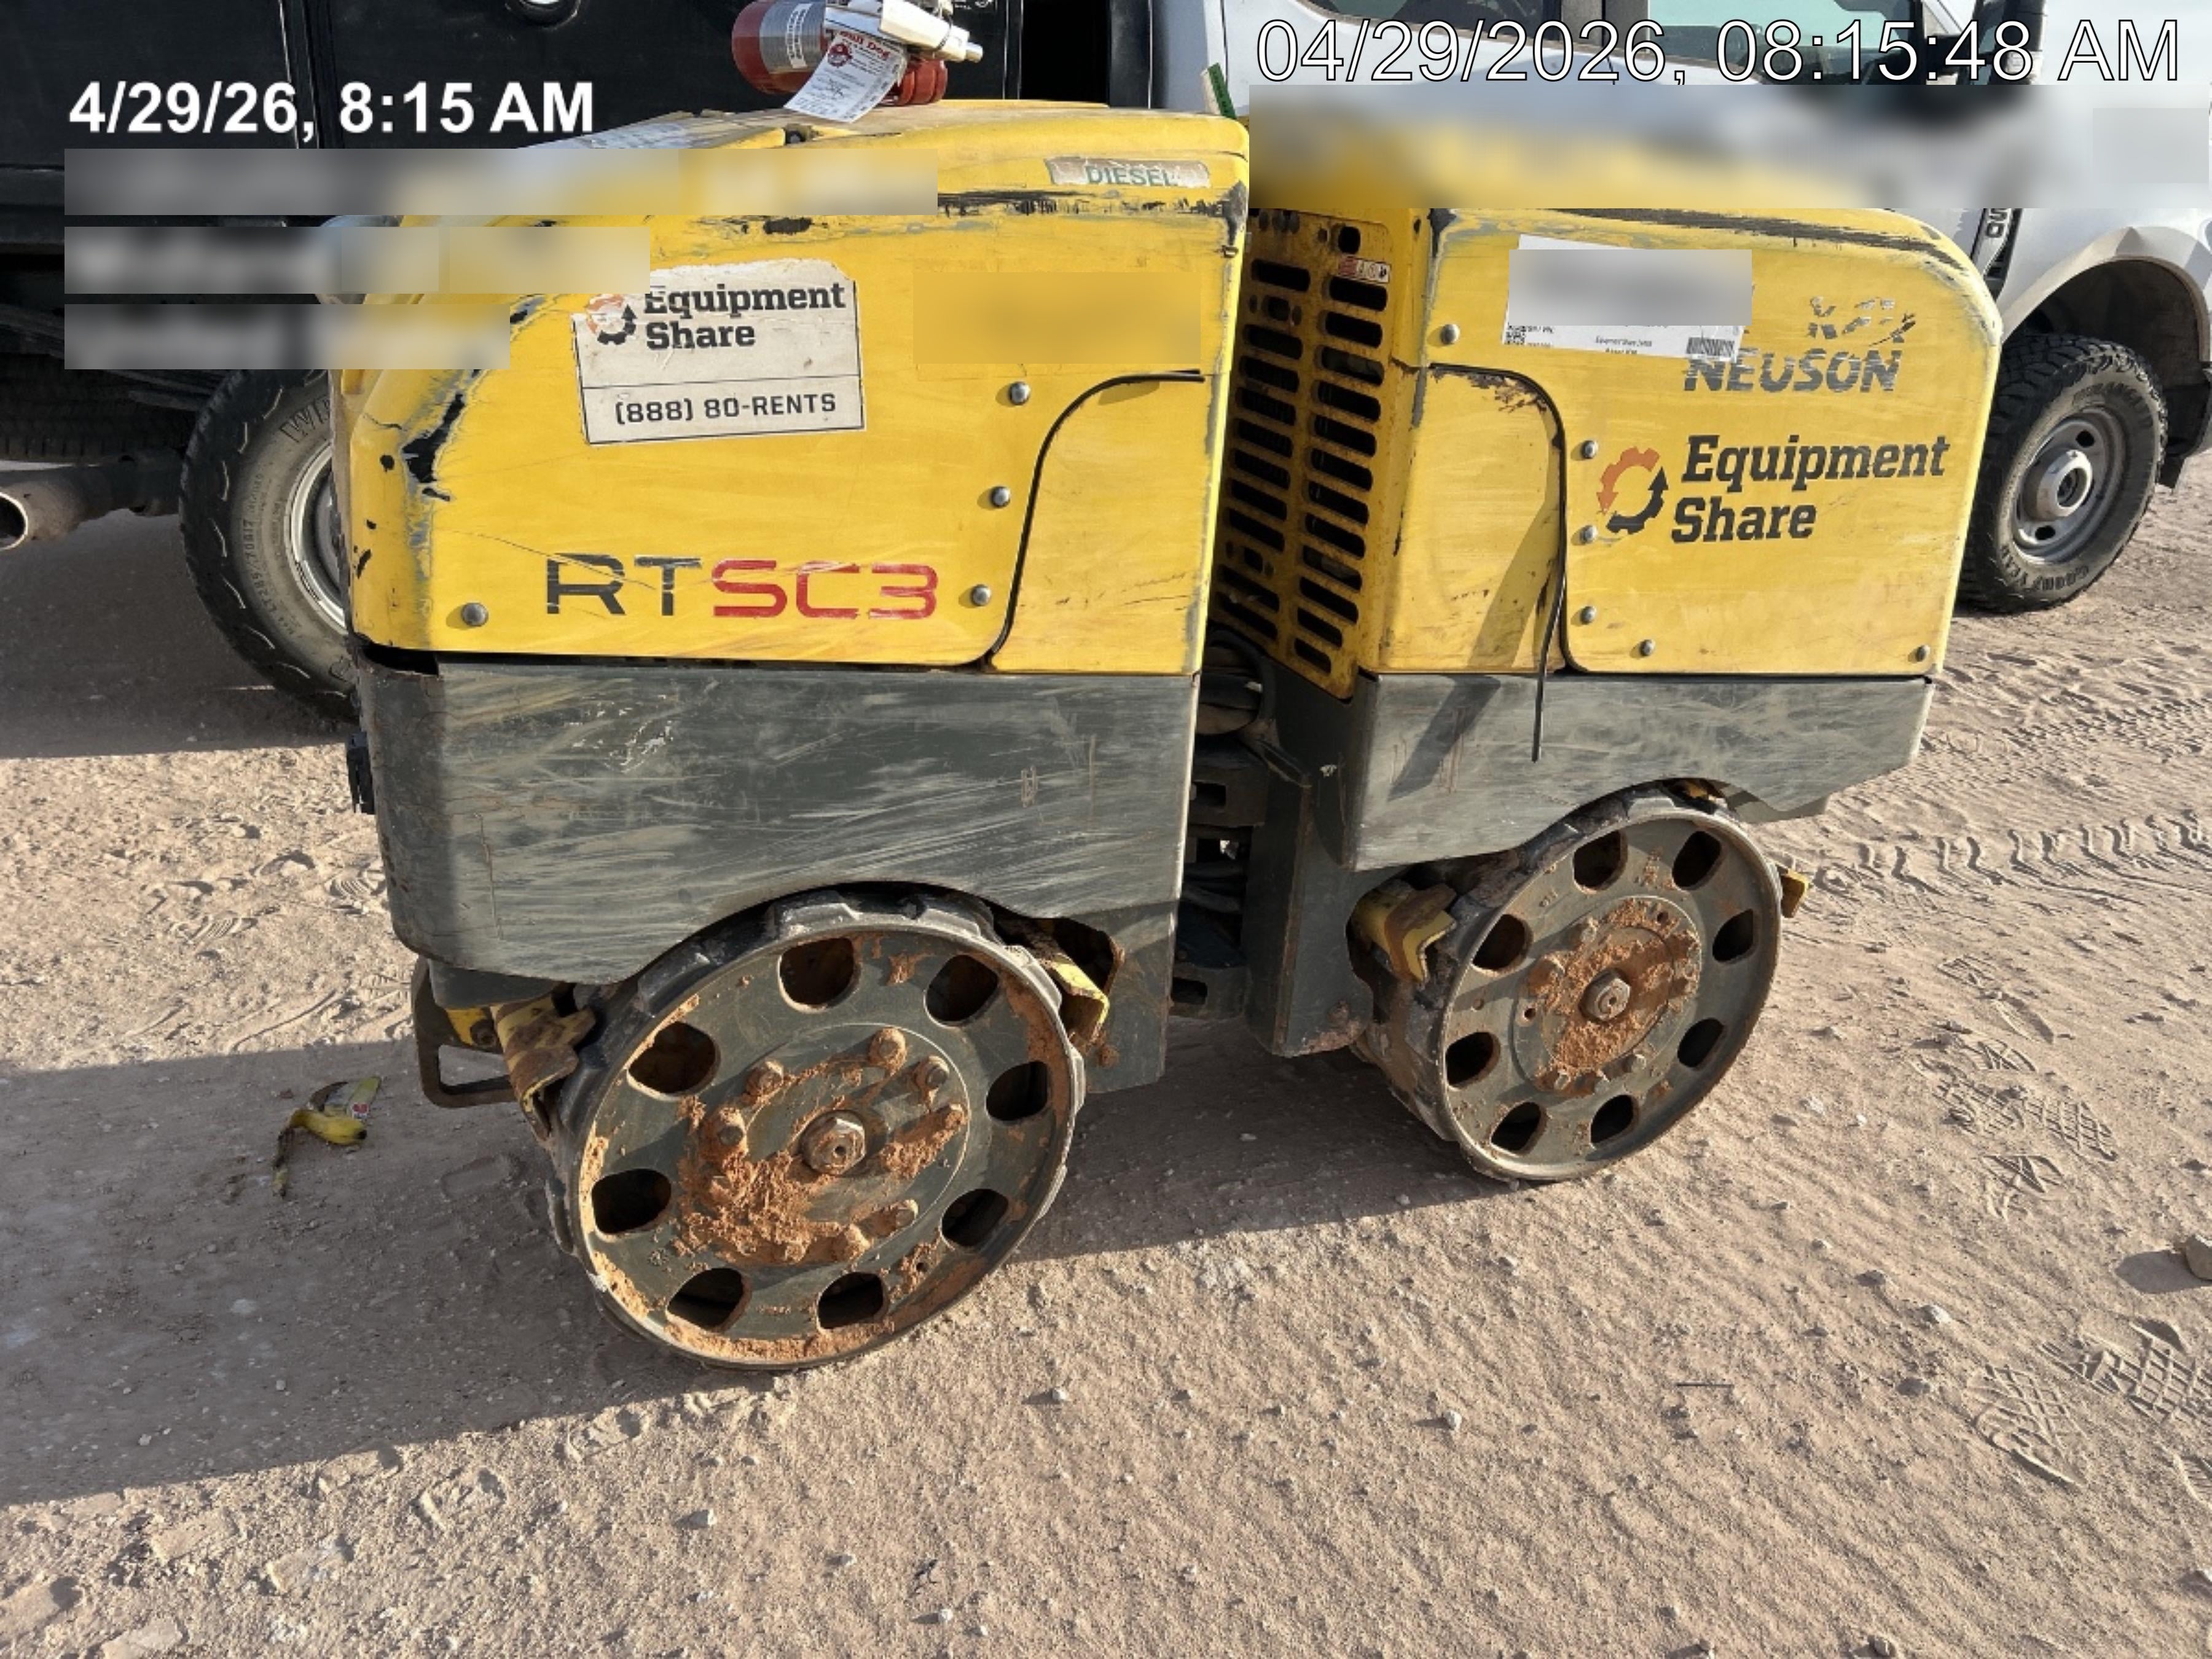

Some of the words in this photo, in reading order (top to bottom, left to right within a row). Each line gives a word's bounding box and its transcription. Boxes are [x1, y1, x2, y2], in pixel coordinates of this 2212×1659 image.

[1086, 166, 1177, 186] DIESEL
[644, 283, 846, 319] Equipment
[646, 321, 756, 350] Share
[1684, 348, 1902, 392] NEUSON
[615, 399, 693, 425] (888)
[704, 393, 836, 418] 80-RENTS
[1682, 434, 1951, 492] Equipment
[1671, 496, 1817, 543] Share
